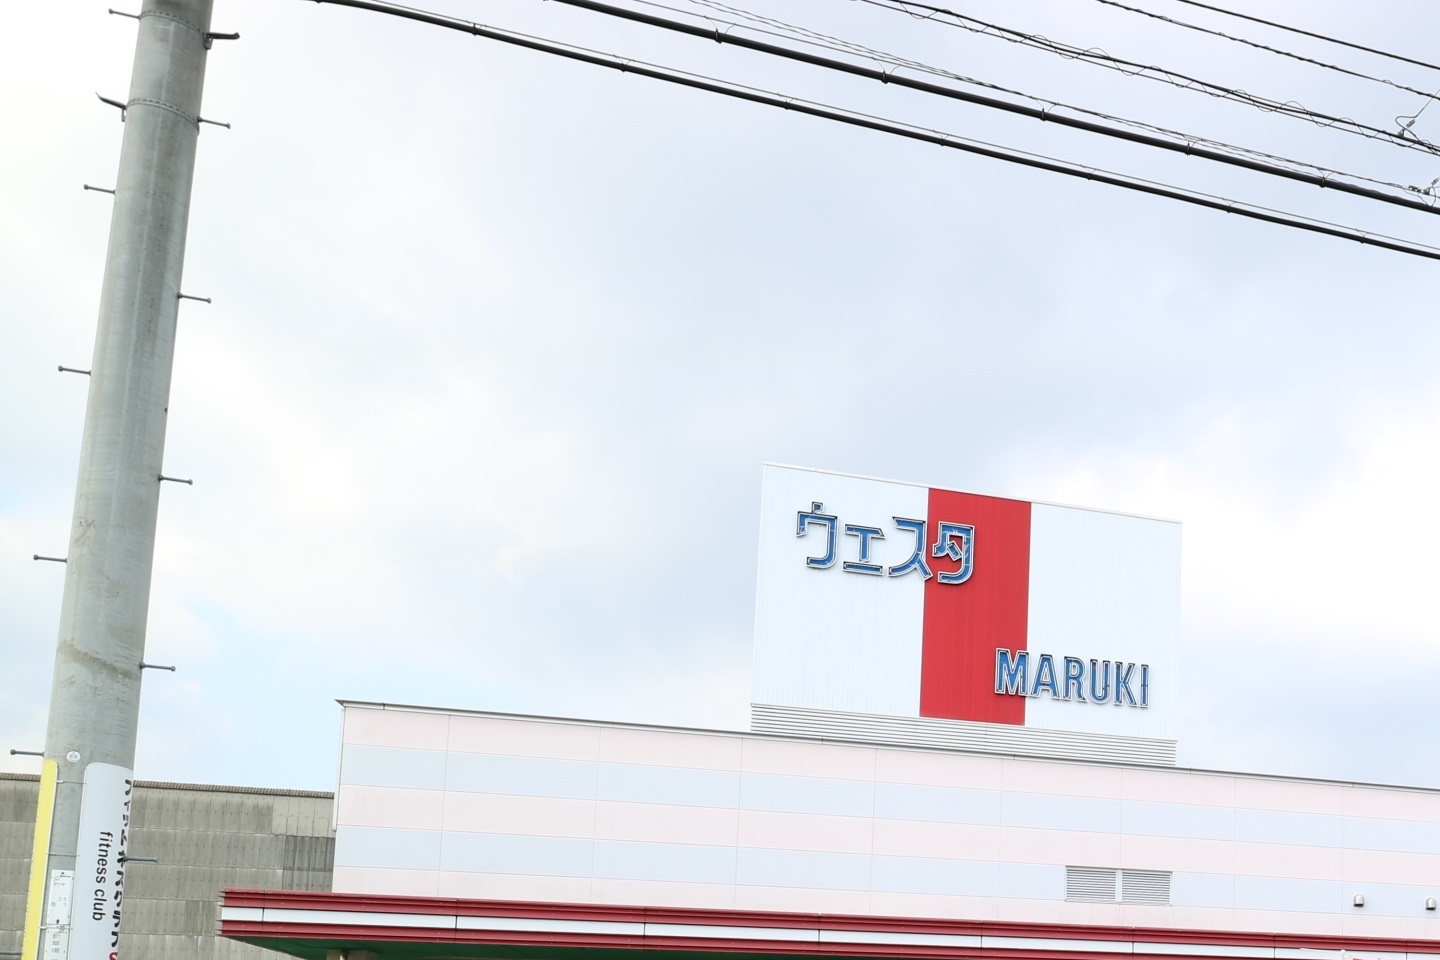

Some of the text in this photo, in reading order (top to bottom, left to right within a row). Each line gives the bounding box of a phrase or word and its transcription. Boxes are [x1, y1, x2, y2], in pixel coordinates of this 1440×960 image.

[796, 501, 975, 585] ウェスタ
[994, 647, 1149, 708] MARUKI
[92, 831, 113, 920] fitness club
